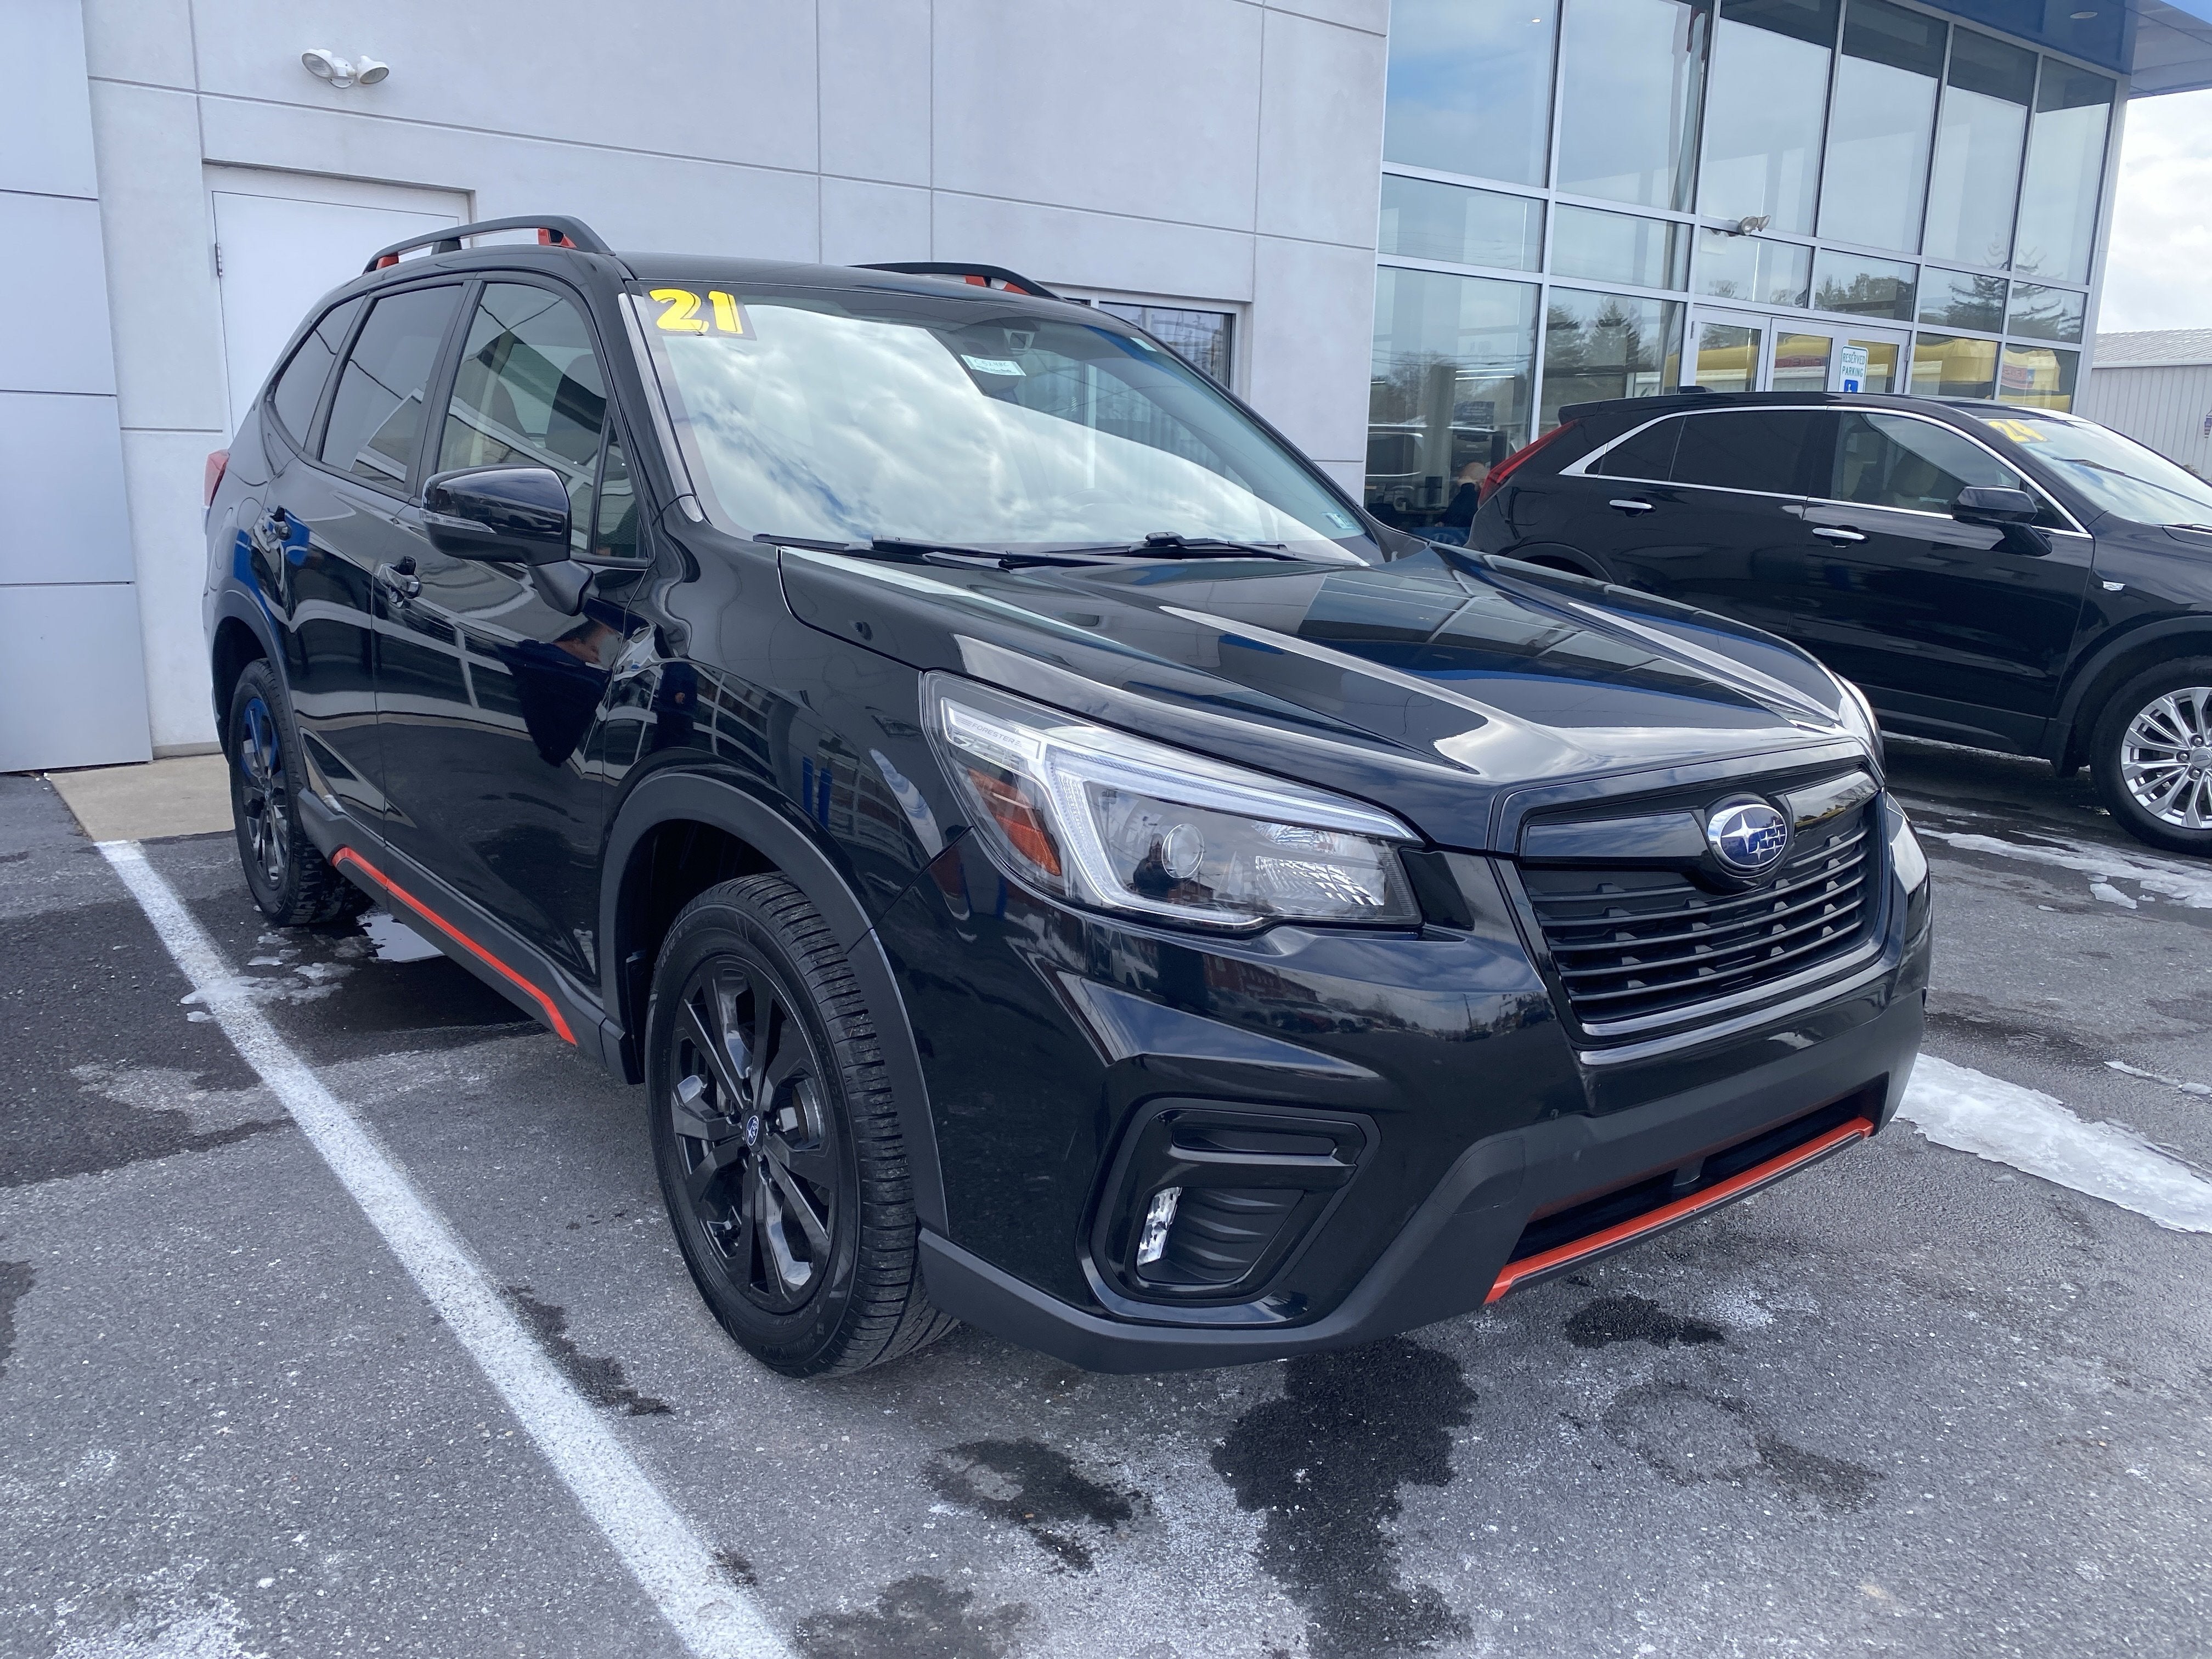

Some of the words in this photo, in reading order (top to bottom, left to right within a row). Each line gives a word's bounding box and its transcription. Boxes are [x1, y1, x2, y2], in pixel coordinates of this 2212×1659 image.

[649, 289, 743, 334] 21
[1843, 353, 1865, 364] RESERVED
[1842, 366, 1863, 377] PARKING
[972, 723, 1015, 744] FORESTER
